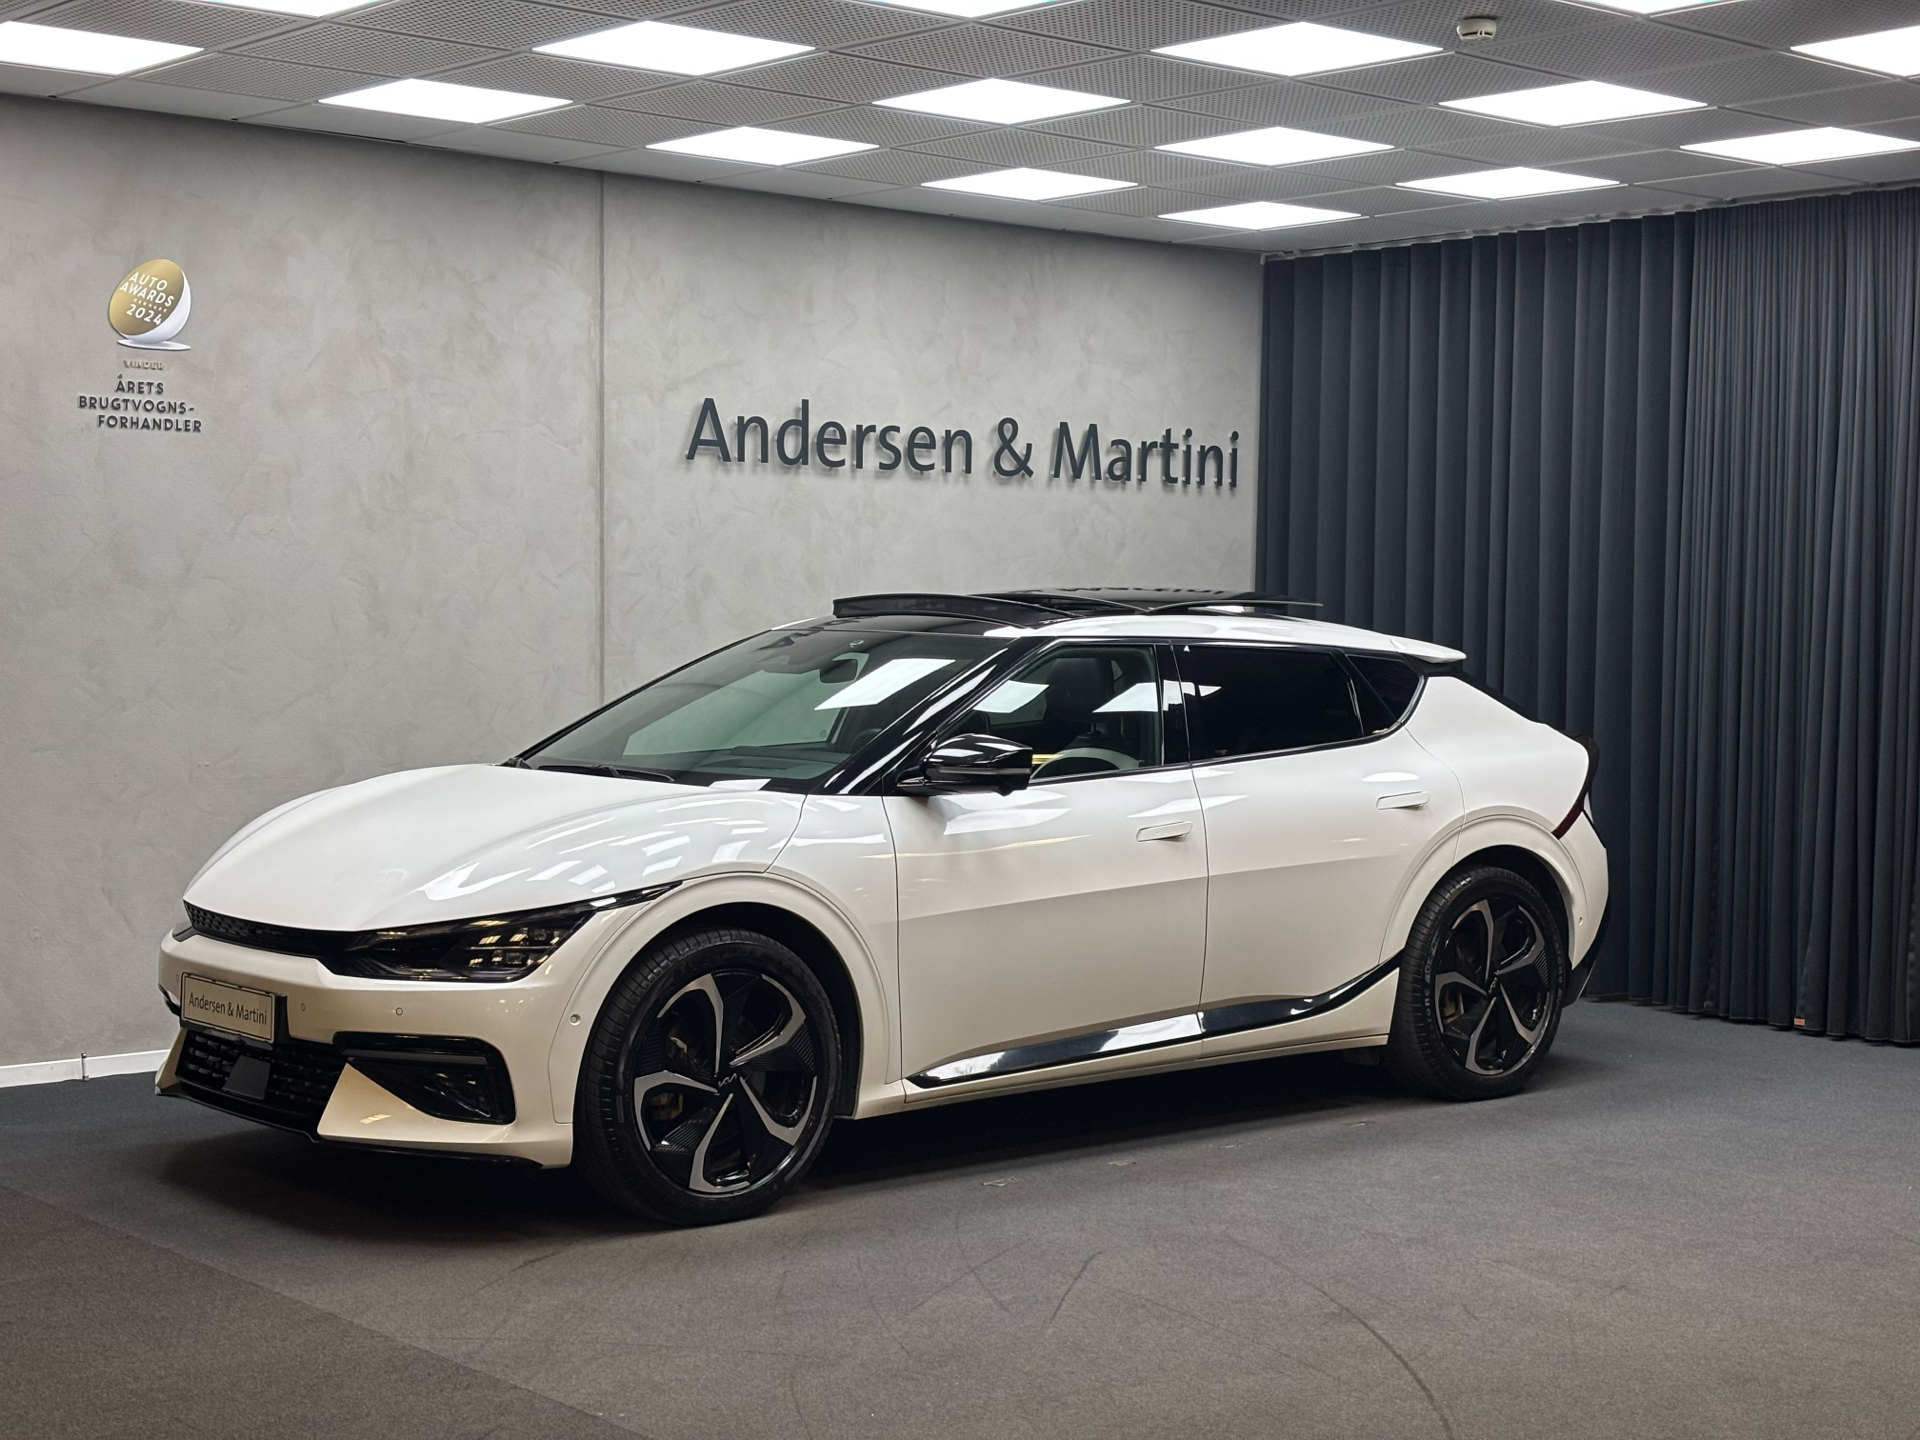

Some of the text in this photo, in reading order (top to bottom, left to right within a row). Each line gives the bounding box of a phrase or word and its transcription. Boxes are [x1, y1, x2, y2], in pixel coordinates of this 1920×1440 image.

[129, 272, 168, 291] AUTO
[119, 281, 174, 307] AWARDS
[126, 304, 162, 326] 2024
[115, 374, 164, 395] ÅRETS
[79, 395, 195, 414] BRUGTVOGNS-
[97, 414, 202, 432] FORHANDLER
[686, 397, 1239, 488] Andersen & Martini
[189, 992, 267, 1025] Andersen & Martini
